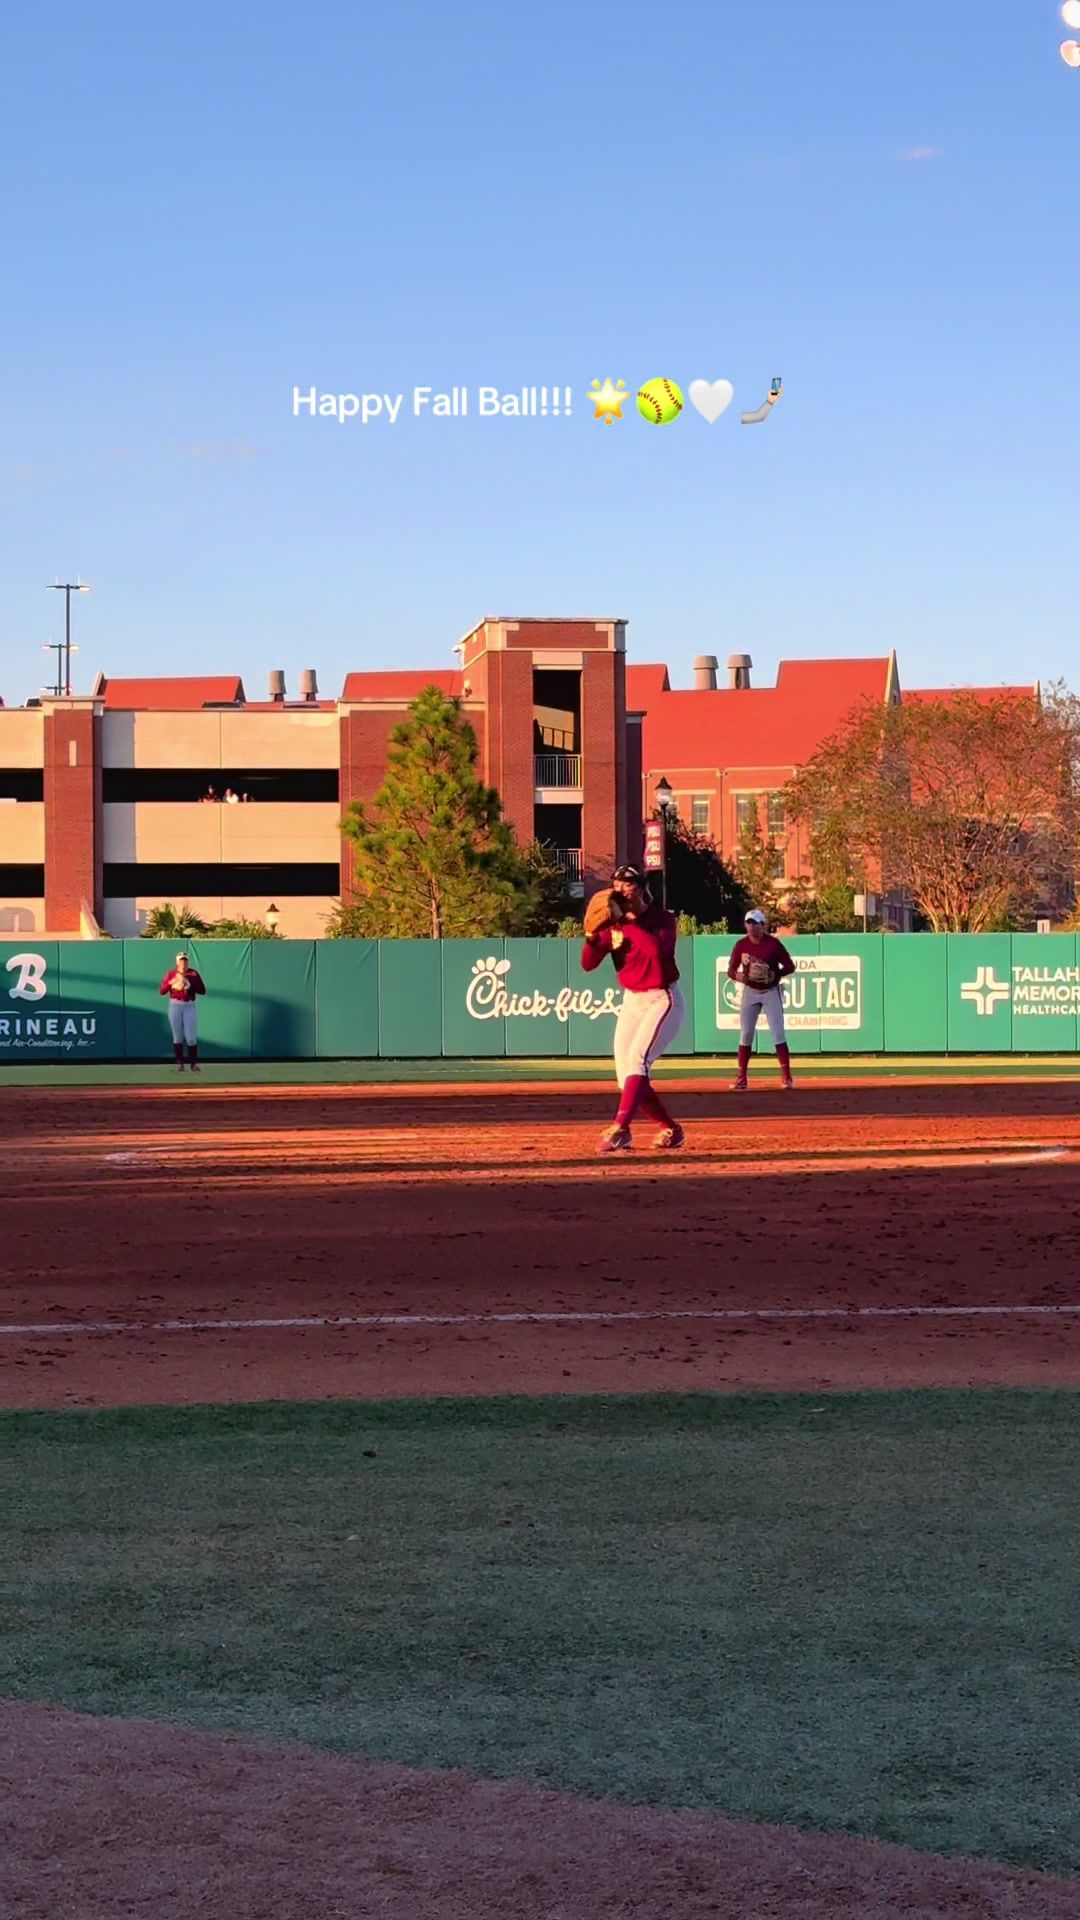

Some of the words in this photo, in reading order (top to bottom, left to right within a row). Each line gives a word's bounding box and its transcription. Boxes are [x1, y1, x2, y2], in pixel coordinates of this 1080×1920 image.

[6, 953, 47, 1001] B
[1012, 966, 1080, 982] TALLAH
[466, 971, 623, 1022] Chick-fil-A
[812, 977, 855, 1009] TAG
[1013, 985, 1080, 1001] MEMOR
[0, 1018, 97, 1035] RINEAU
